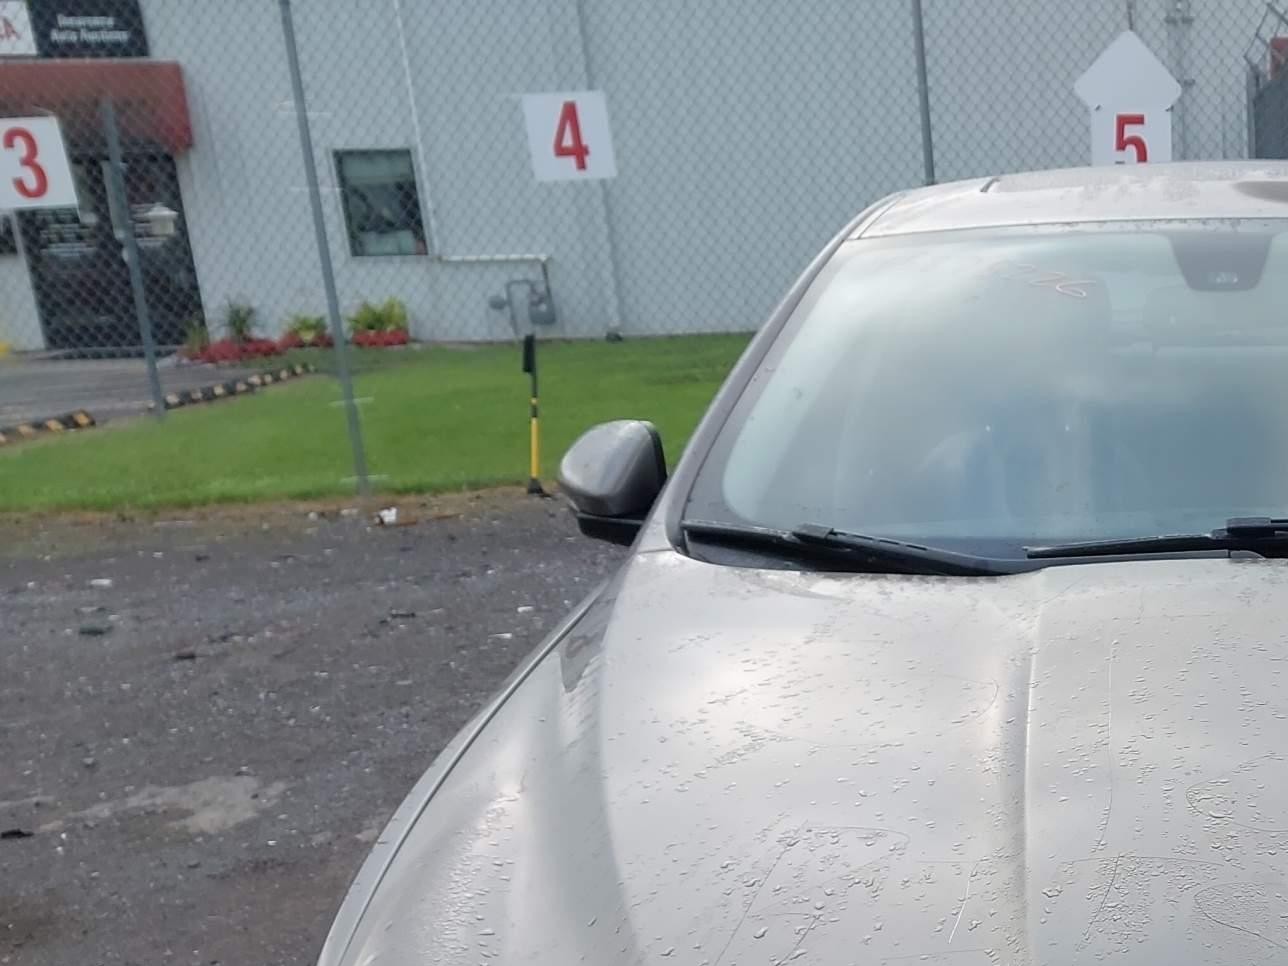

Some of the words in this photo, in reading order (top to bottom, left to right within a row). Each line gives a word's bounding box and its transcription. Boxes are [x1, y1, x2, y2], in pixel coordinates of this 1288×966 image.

[3, 127, 48, 198] 3
[553, 100, 590, 171] 4
[1115, 113, 1148, 164] 5
